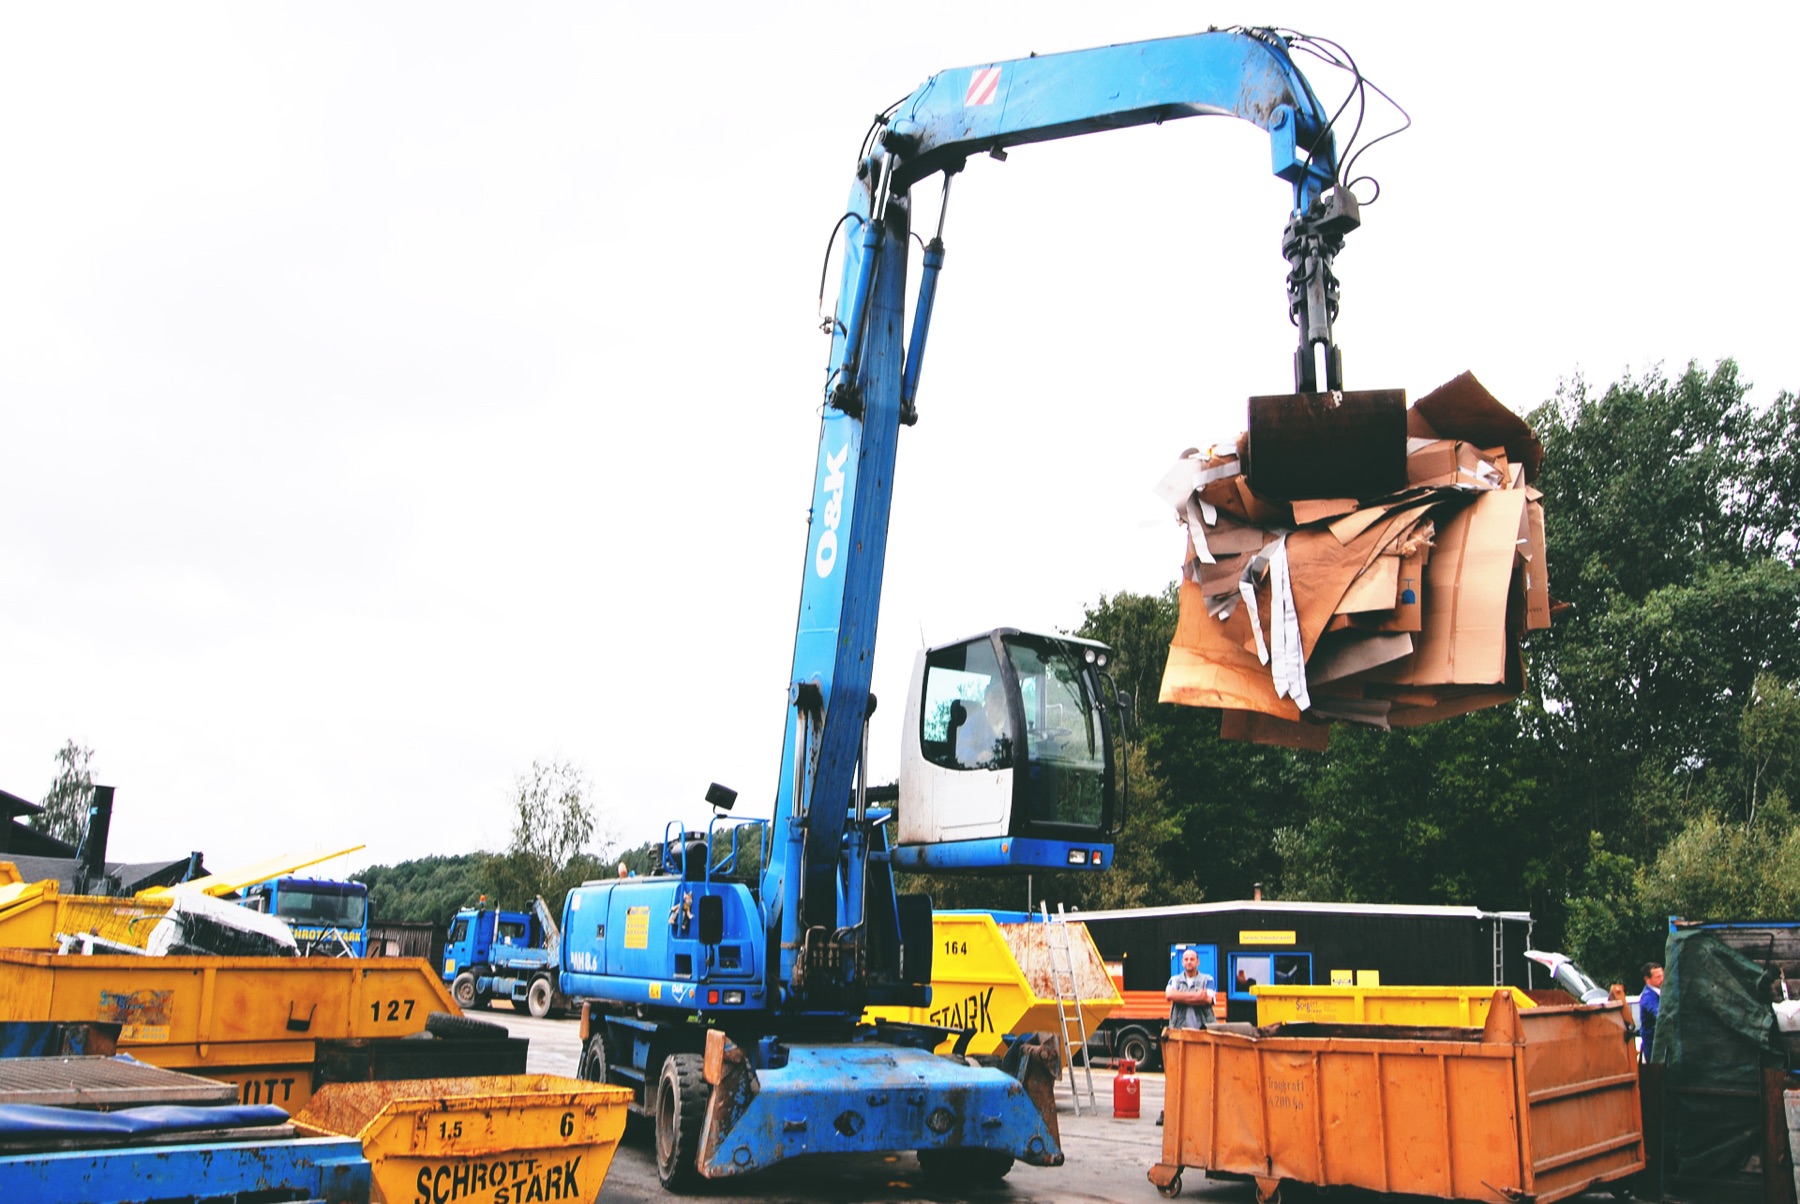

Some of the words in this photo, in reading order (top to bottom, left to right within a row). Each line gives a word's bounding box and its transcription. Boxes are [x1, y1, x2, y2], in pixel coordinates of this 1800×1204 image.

[816, 443, 849, 578] O&K
[945, 941, 967, 955] 164
[371, 1000, 415, 1022] 127
[560, 1112, 575, 1138] 6
[494, 1155, 582, 1204] STARK
